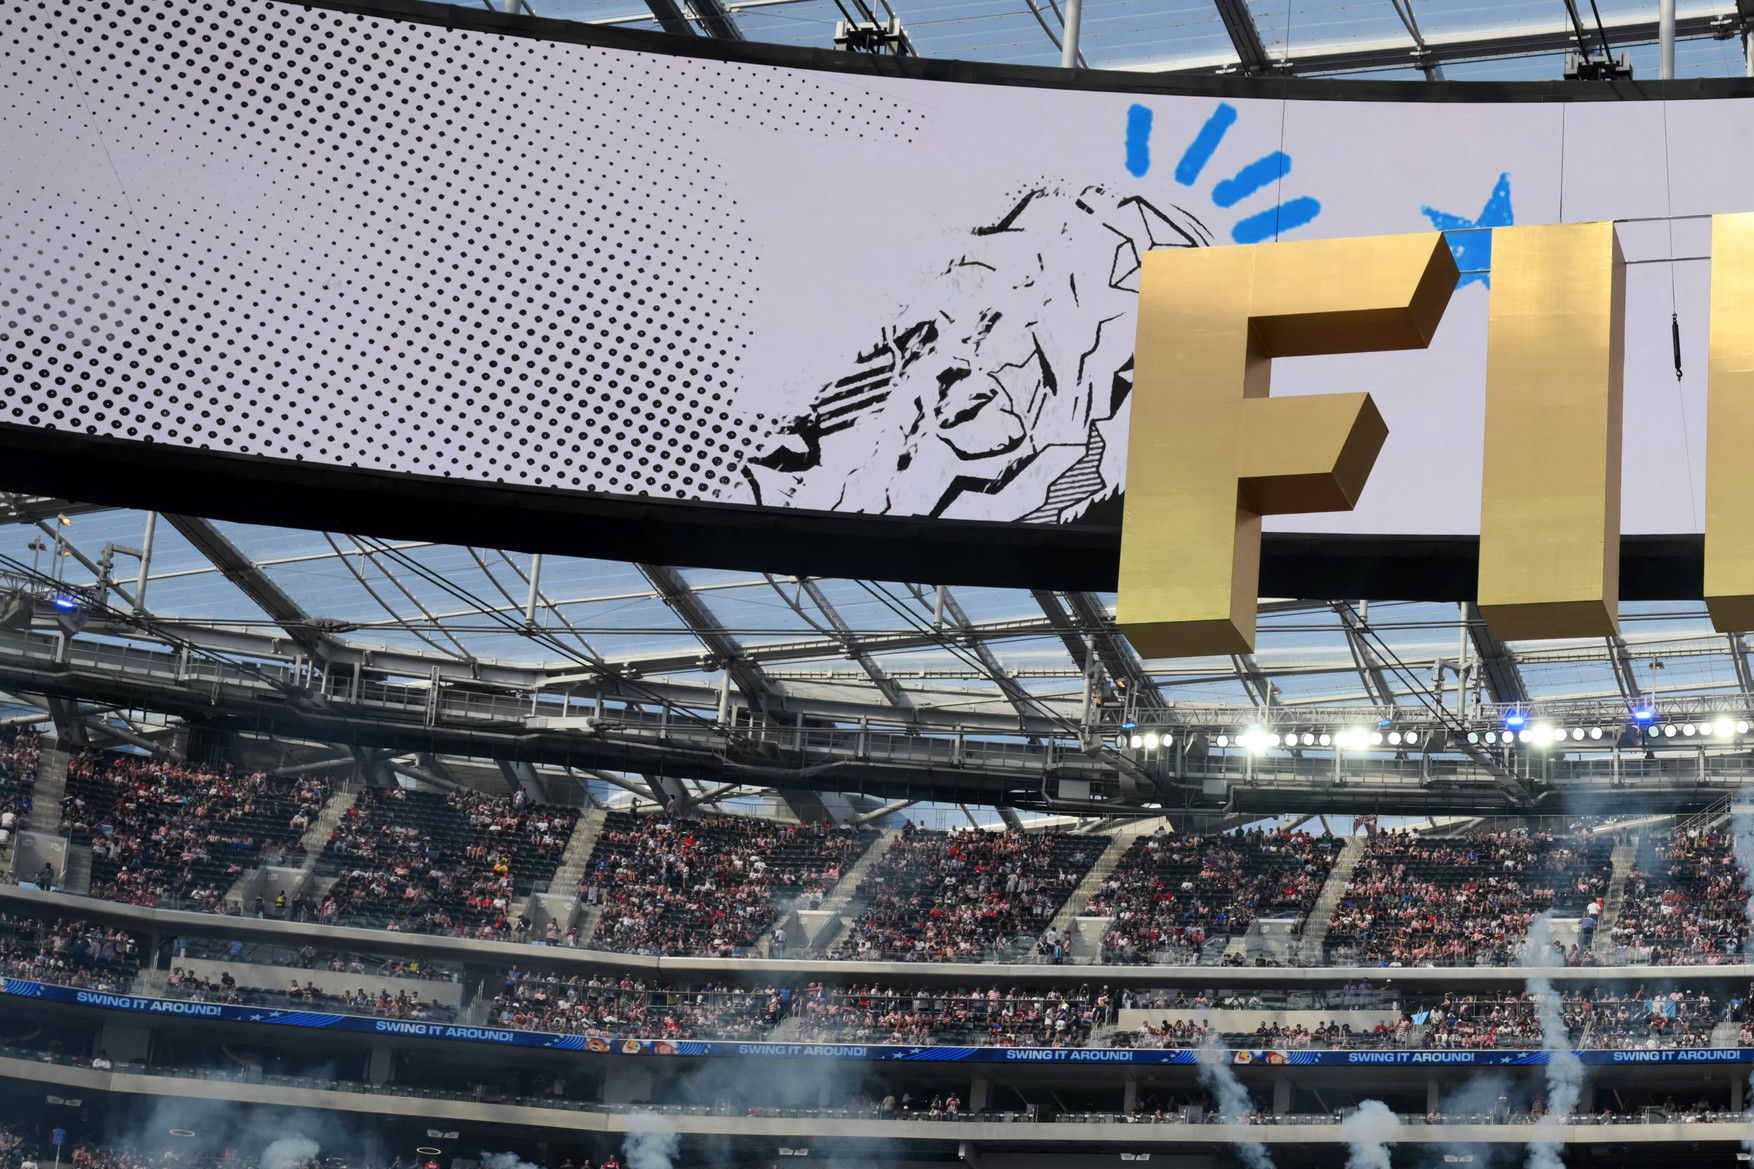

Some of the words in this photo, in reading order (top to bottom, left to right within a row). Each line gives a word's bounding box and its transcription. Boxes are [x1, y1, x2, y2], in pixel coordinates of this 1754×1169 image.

[76, 991, 130, 1008] SWING
[133, 999, 148, 1009] IT
[150, 1000, 222, 1016] AROUND!
[376, 1021, 426, 1034] SWING
[428, 1026, 443, 1036] IT
[446, 1027, 514, 1042] AROUND!
[739, 1045, 785, 1055] SWING
[789, 1046, 801, 1055] IT
[804, 1046, 867, 1056] AROUND!
[1006, 1050, 1052, 1060] SWING
[1055, 1051, 1067, 1060] IT
[1070, 1051, 1132, 1060] AROUND!
[1613, 1051, 1659, 1061] SWING
[1662, 1051, 1674, 1060] IT
[1677, 1050, 1740, 1060] AROUND!
[1348, 1052, 1394, 1062] SWING
[1397, 1052, 1409, 1062] IT
[1412, 1052, 1474, 1062] AROUND!
